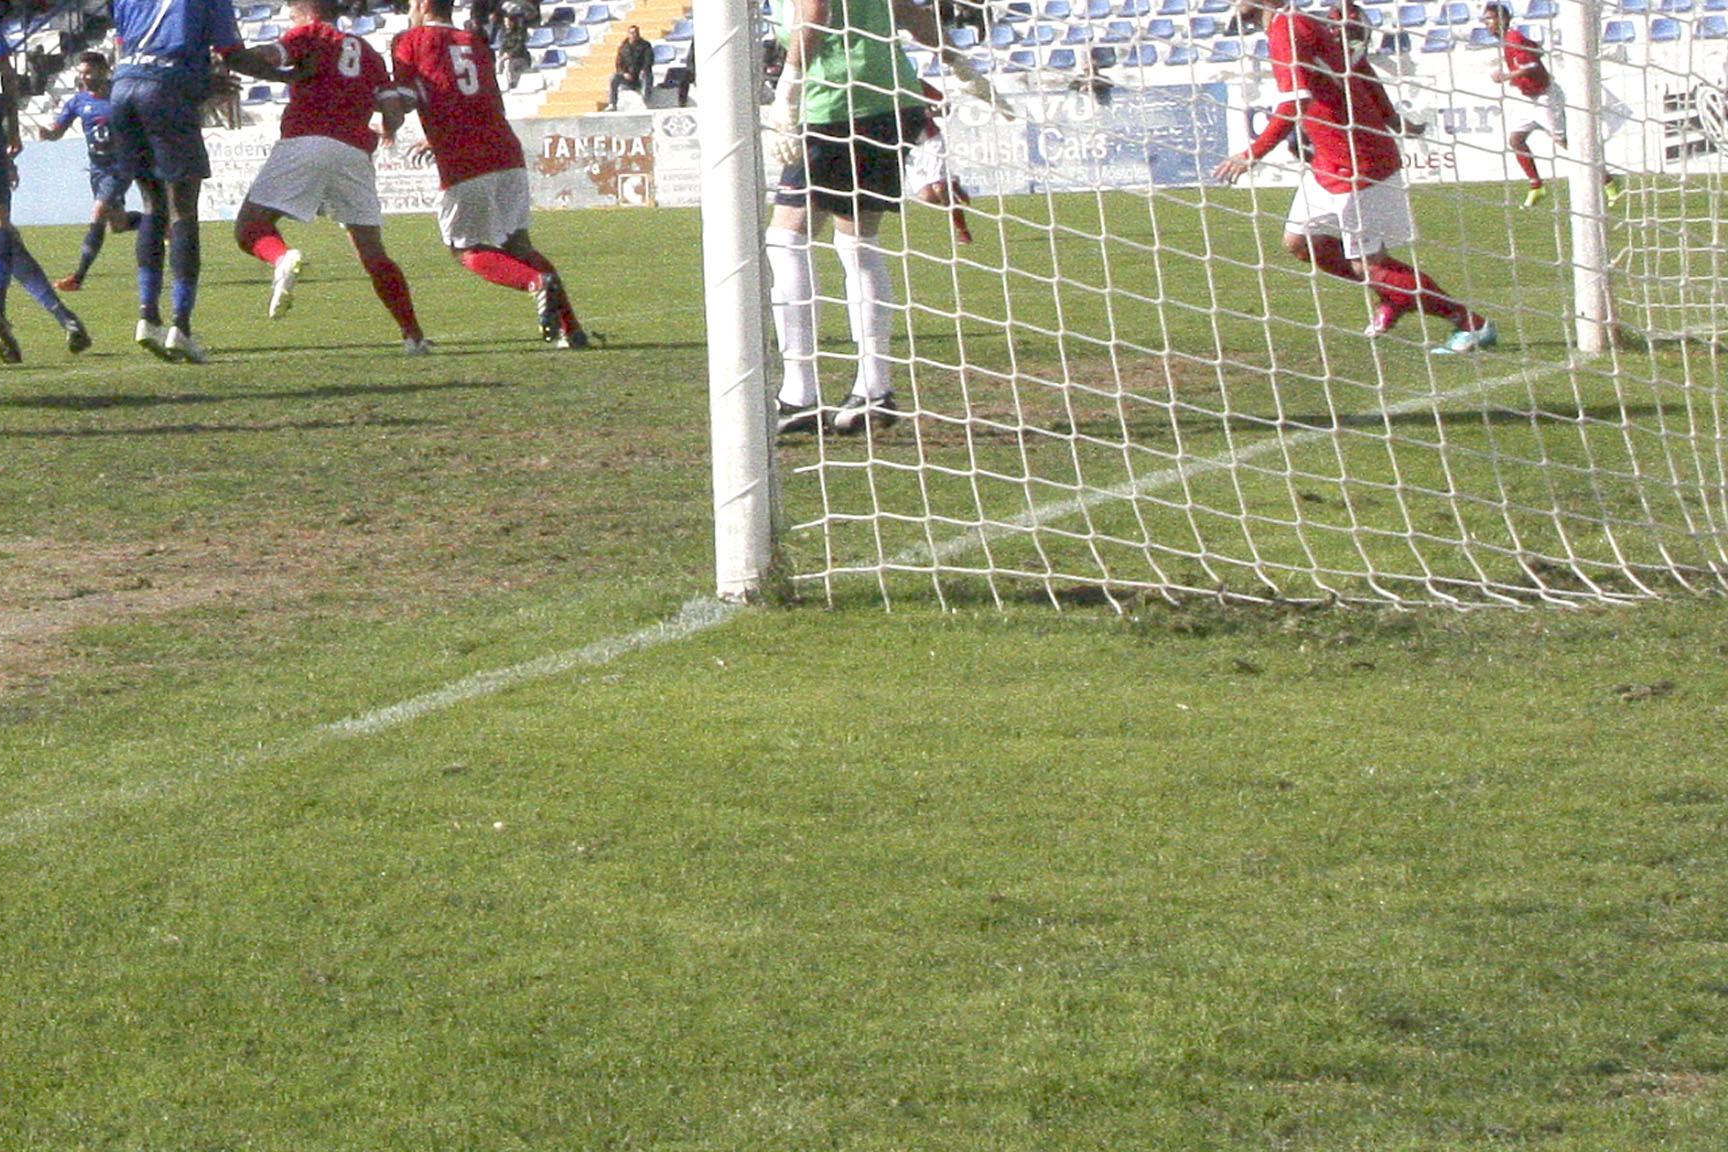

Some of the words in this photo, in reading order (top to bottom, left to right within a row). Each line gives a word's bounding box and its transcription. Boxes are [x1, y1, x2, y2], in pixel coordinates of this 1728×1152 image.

[337, 37, 362, 78] 8
[448, 45, 480, 96] 5
[1038, 128, 1109, 161] Cars
